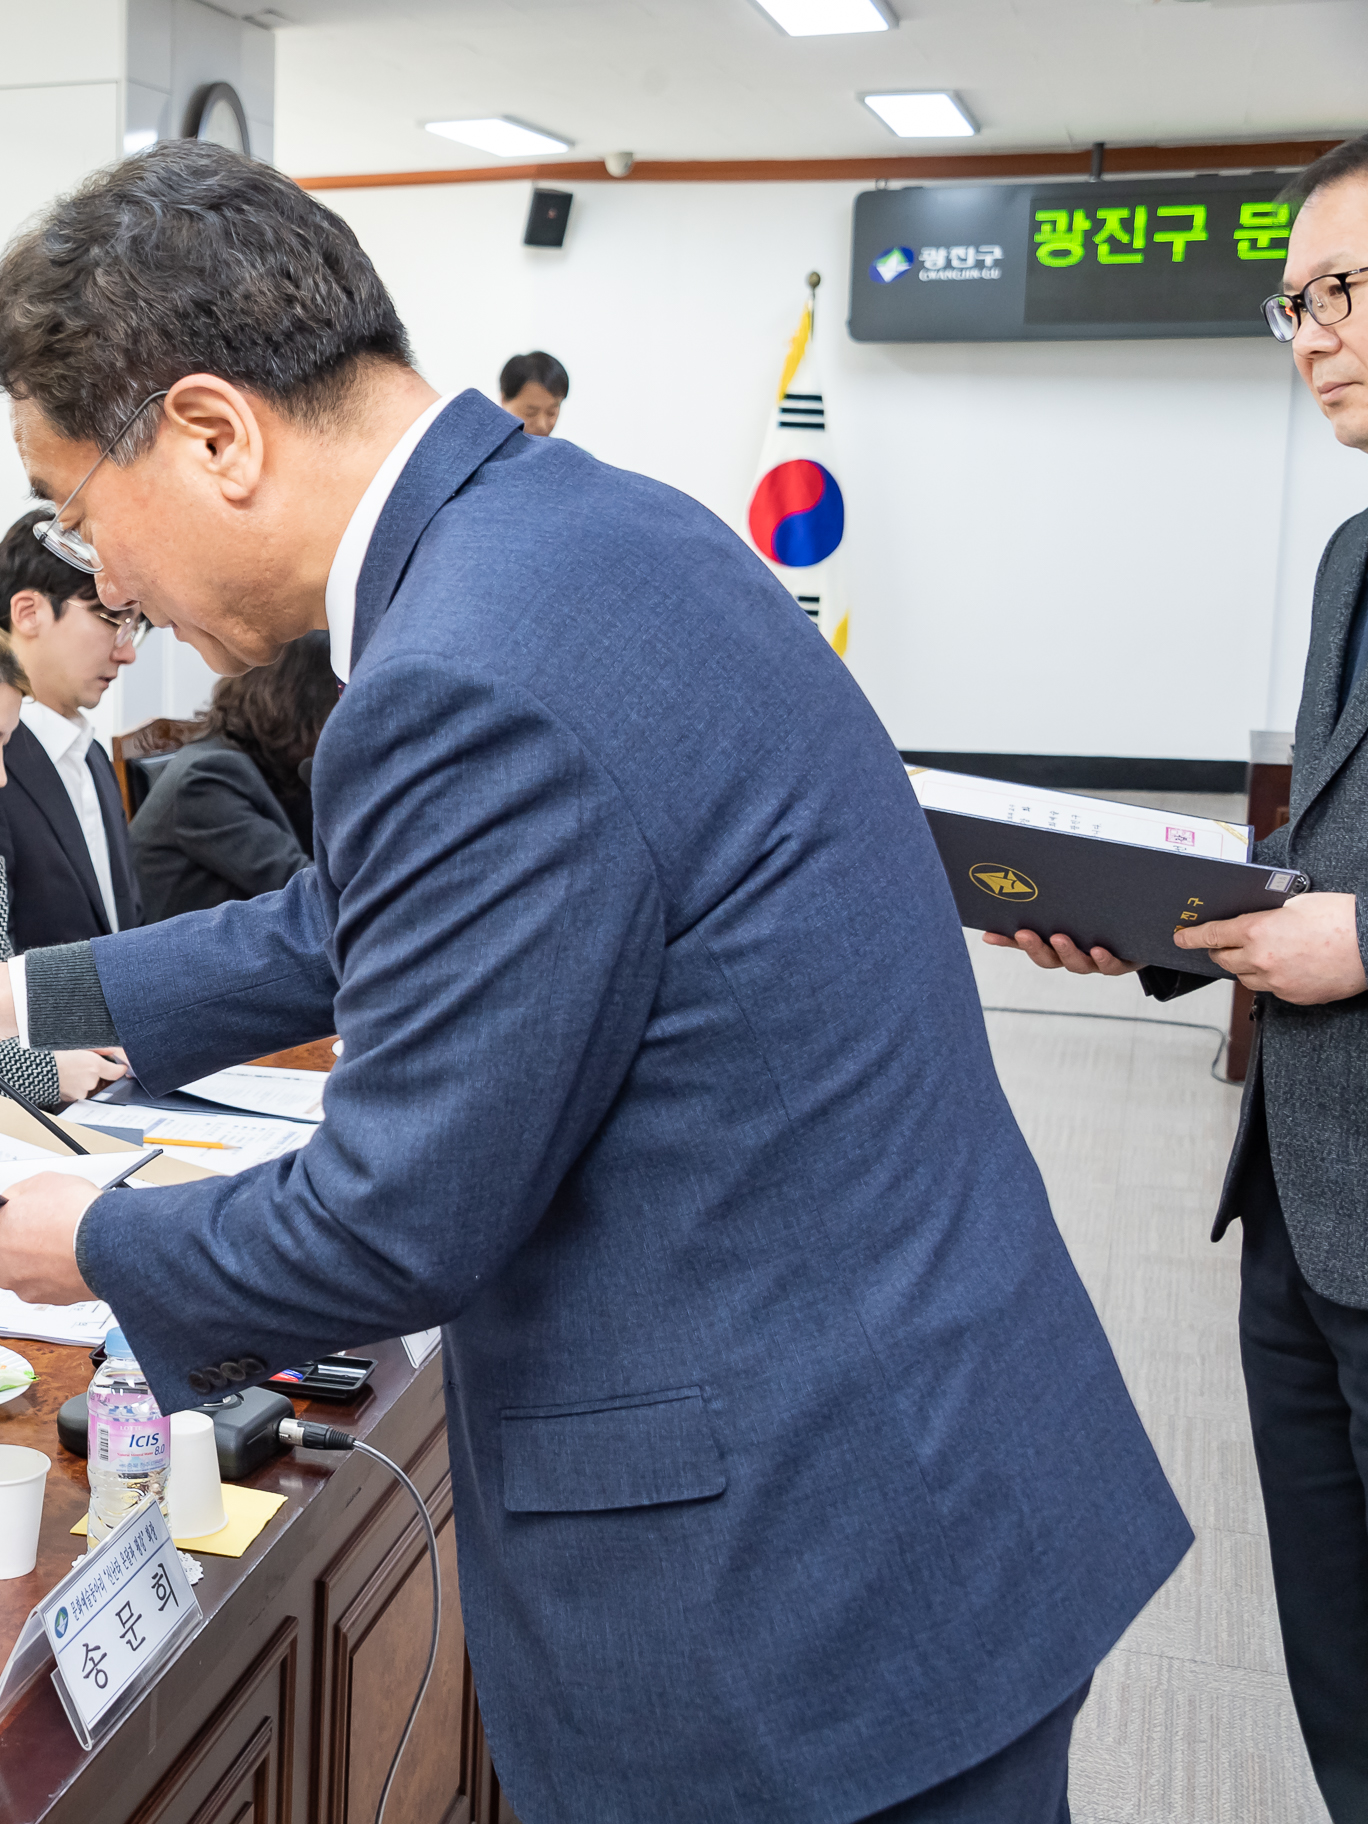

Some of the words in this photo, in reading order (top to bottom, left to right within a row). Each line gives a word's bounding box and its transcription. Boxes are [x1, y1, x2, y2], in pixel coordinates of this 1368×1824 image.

[1034, 204, 1209, 268] 광진구
[1233, 201, 1291, 261] 문
[919, 245, 1004, 270] 광진구
[154, 1444, 165, 1456] 8.0
